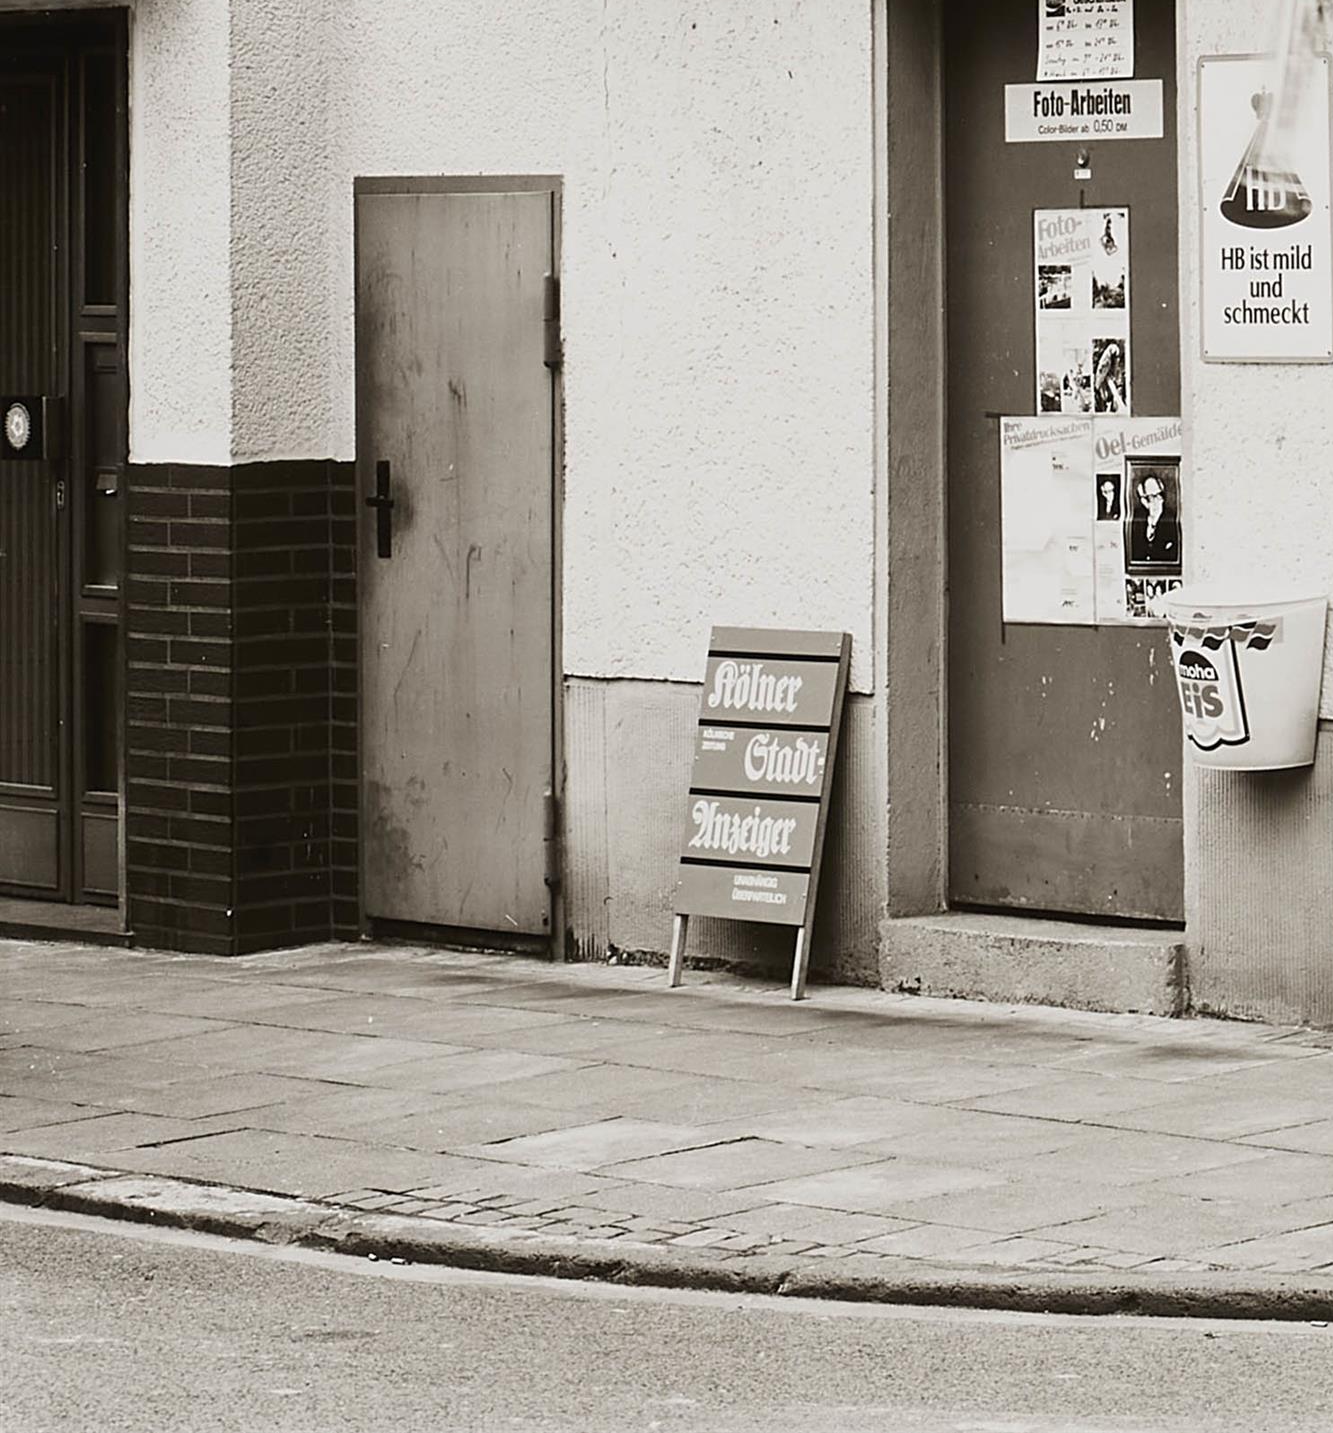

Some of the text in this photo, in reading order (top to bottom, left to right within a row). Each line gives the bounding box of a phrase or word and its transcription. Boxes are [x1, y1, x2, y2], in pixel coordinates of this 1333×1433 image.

[1033, 88, 1132, 118] Foto-Arbeiten
[1221, 245, 1313, 270] HB ist mild
[1249, 274, 1283, 299] und
[1223, 299, 1310, 326] schmeckt
[707, 659, 802, 713] Kölner
[688, 799, 797, 858] Anzeiger
